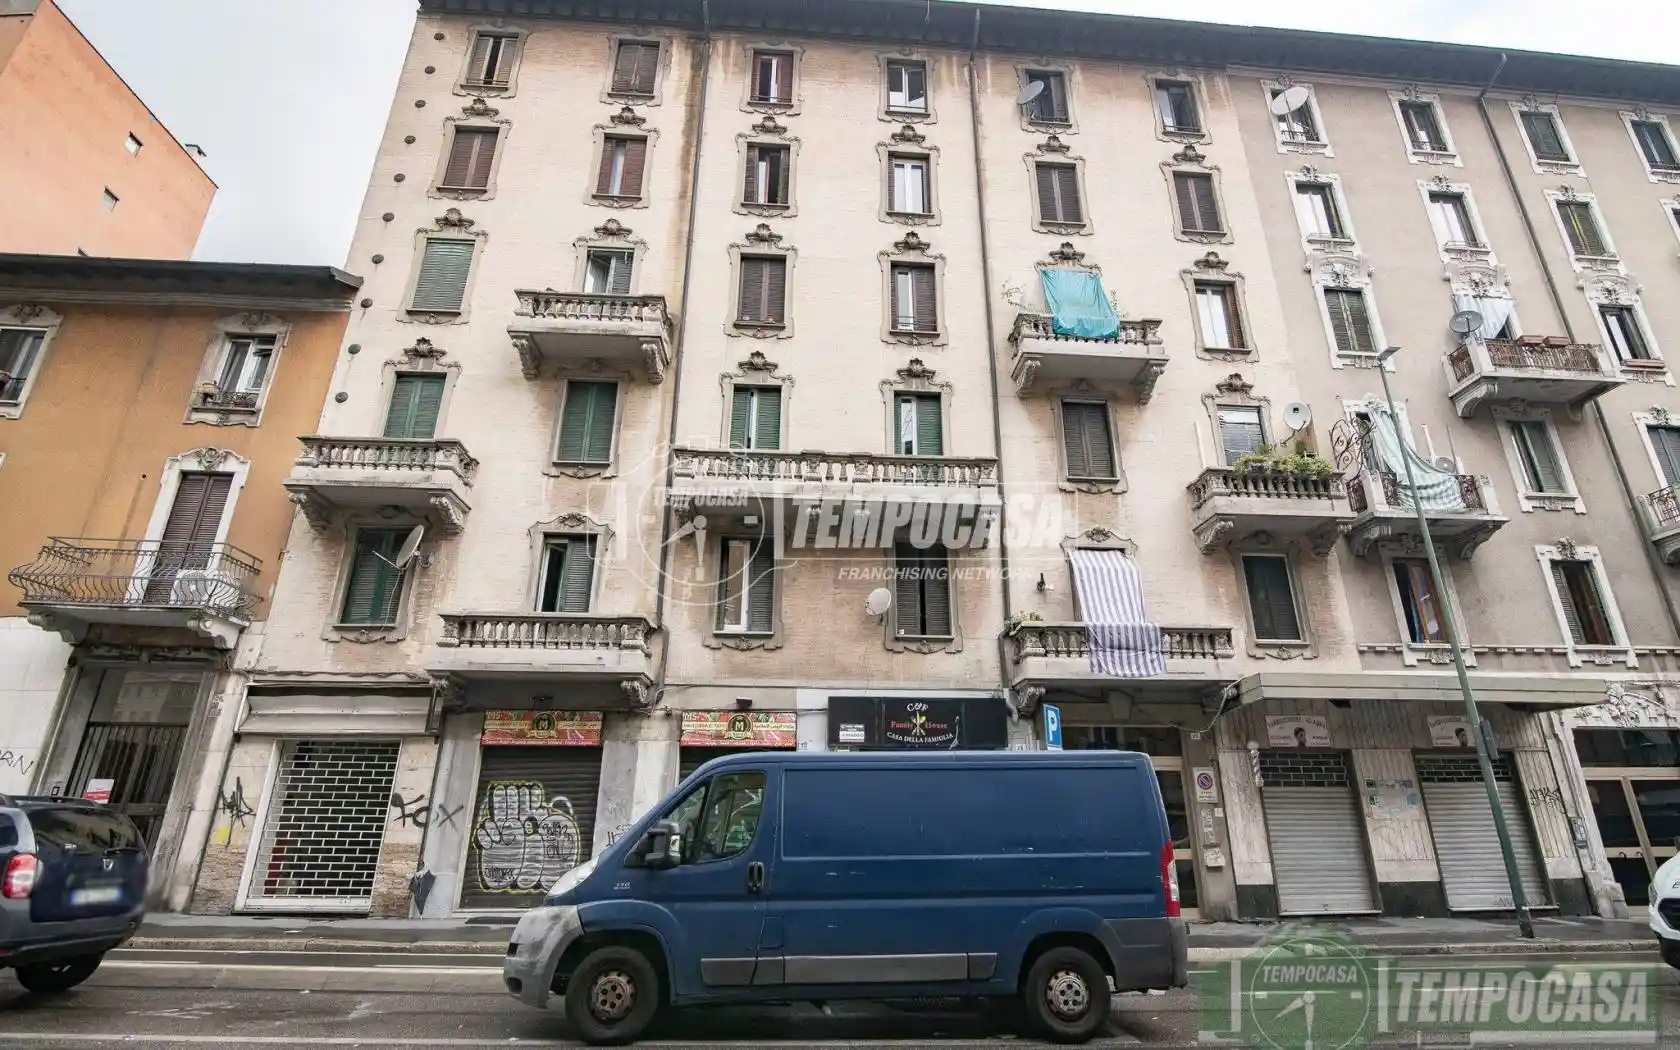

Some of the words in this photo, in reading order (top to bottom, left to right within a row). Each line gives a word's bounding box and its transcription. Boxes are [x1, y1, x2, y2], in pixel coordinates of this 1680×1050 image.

[734, 721, 745, 732] M
[889, 720, 914, 730] Family
[925, 720, 949, 729] House
[1047, 709, 1058, 741] P
[886, 731, 904, 742] CASA
[903, 735, 924, 744] DELLA
